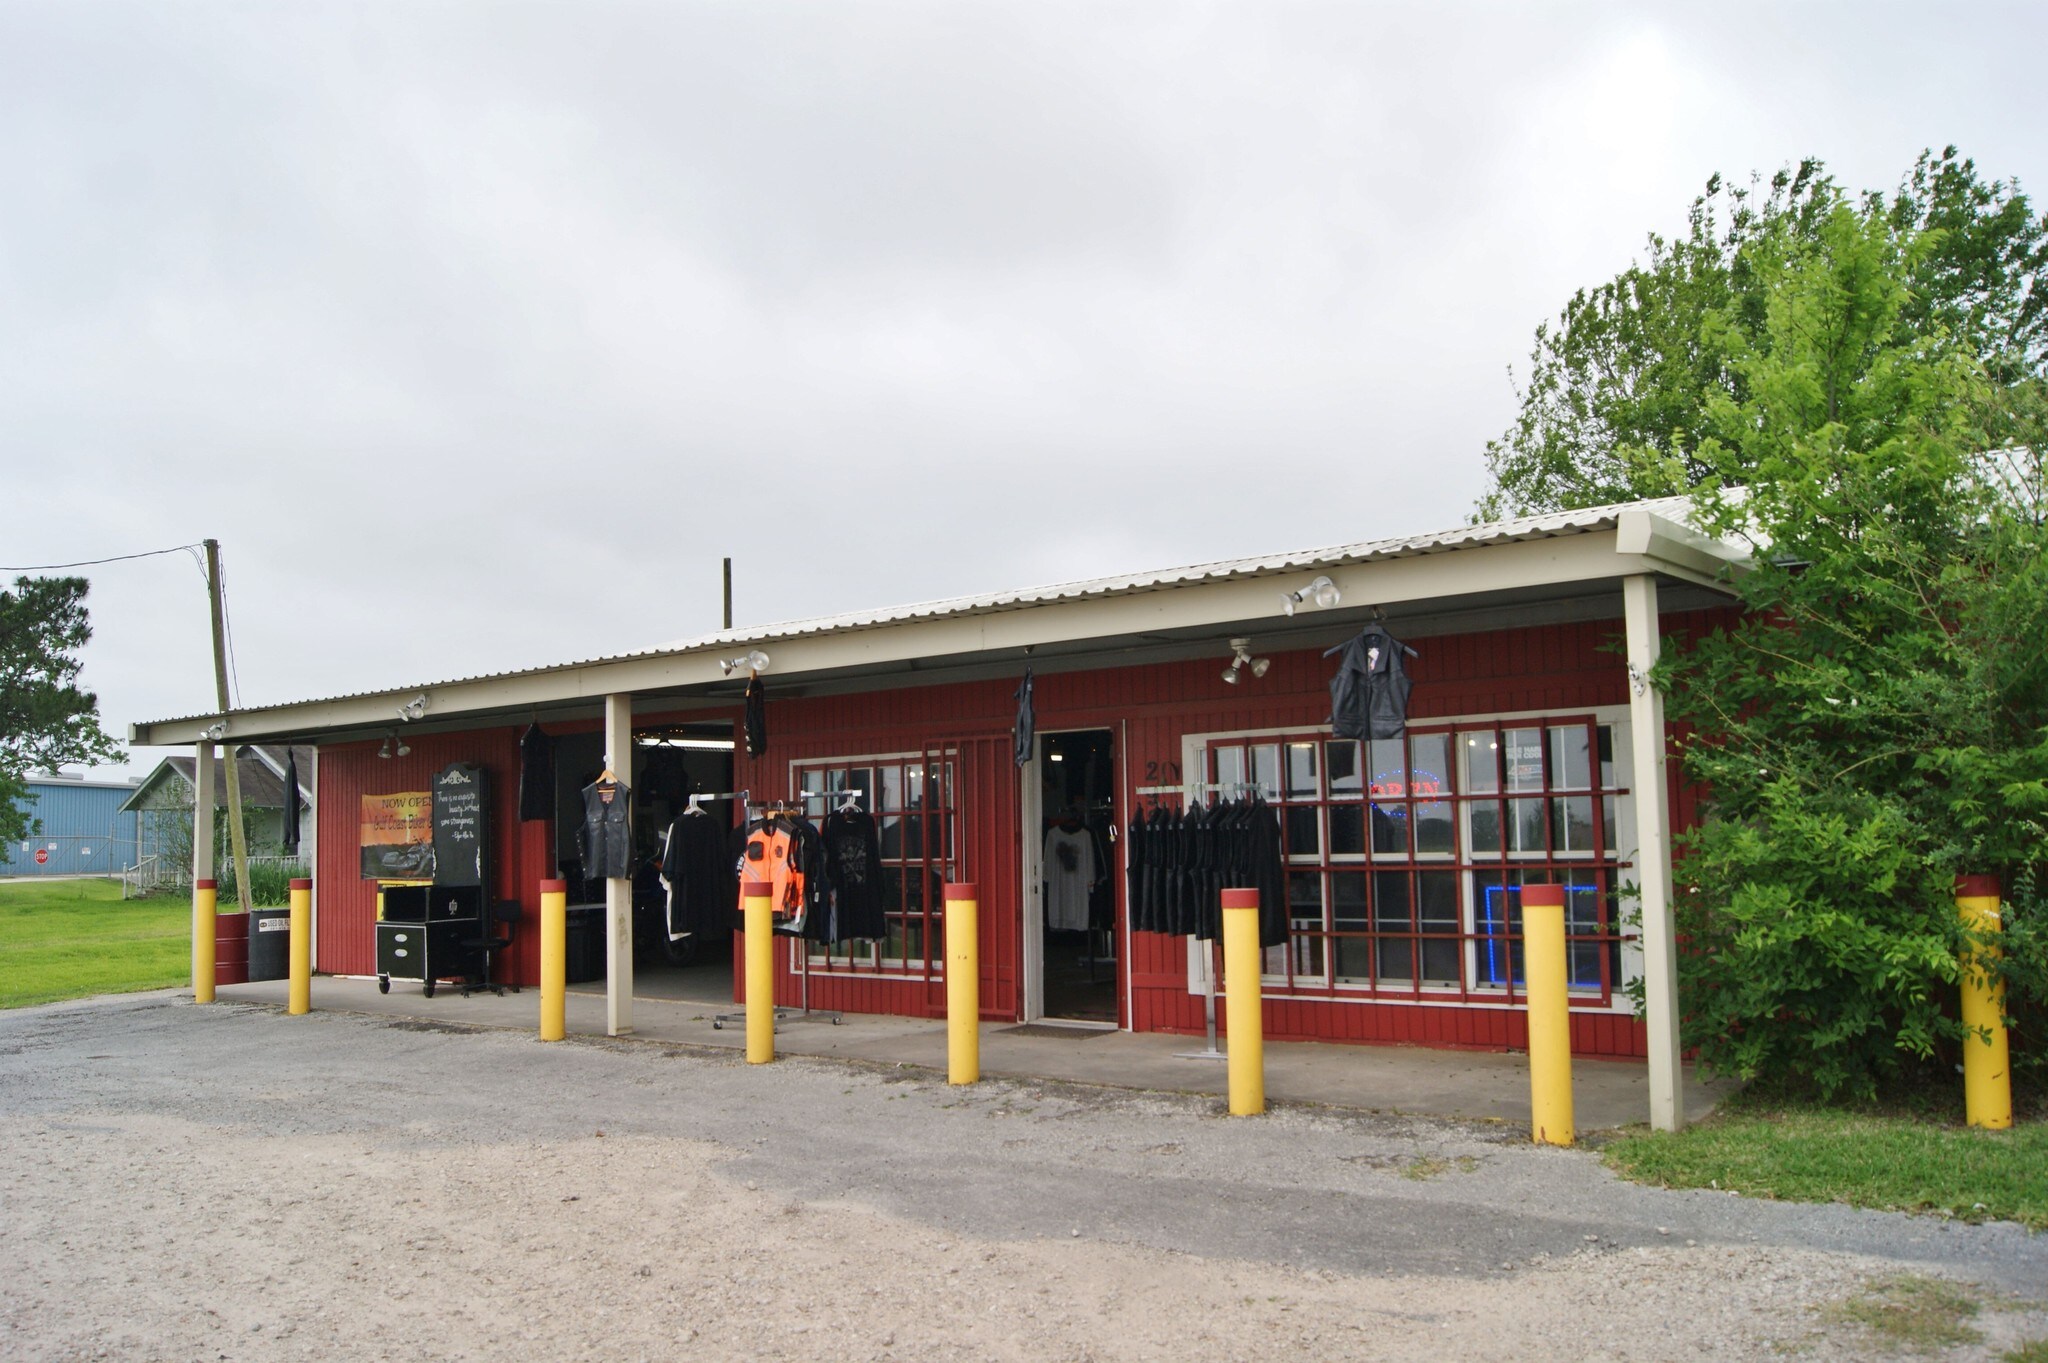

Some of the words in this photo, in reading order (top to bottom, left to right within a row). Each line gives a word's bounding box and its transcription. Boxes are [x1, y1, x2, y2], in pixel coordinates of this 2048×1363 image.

[382, 798, 406, 809] NOW
[374, 815, 388, 831] Gulf
[388, 815, 407, 830] Coast
[408, 814, 426, 829] Biker
